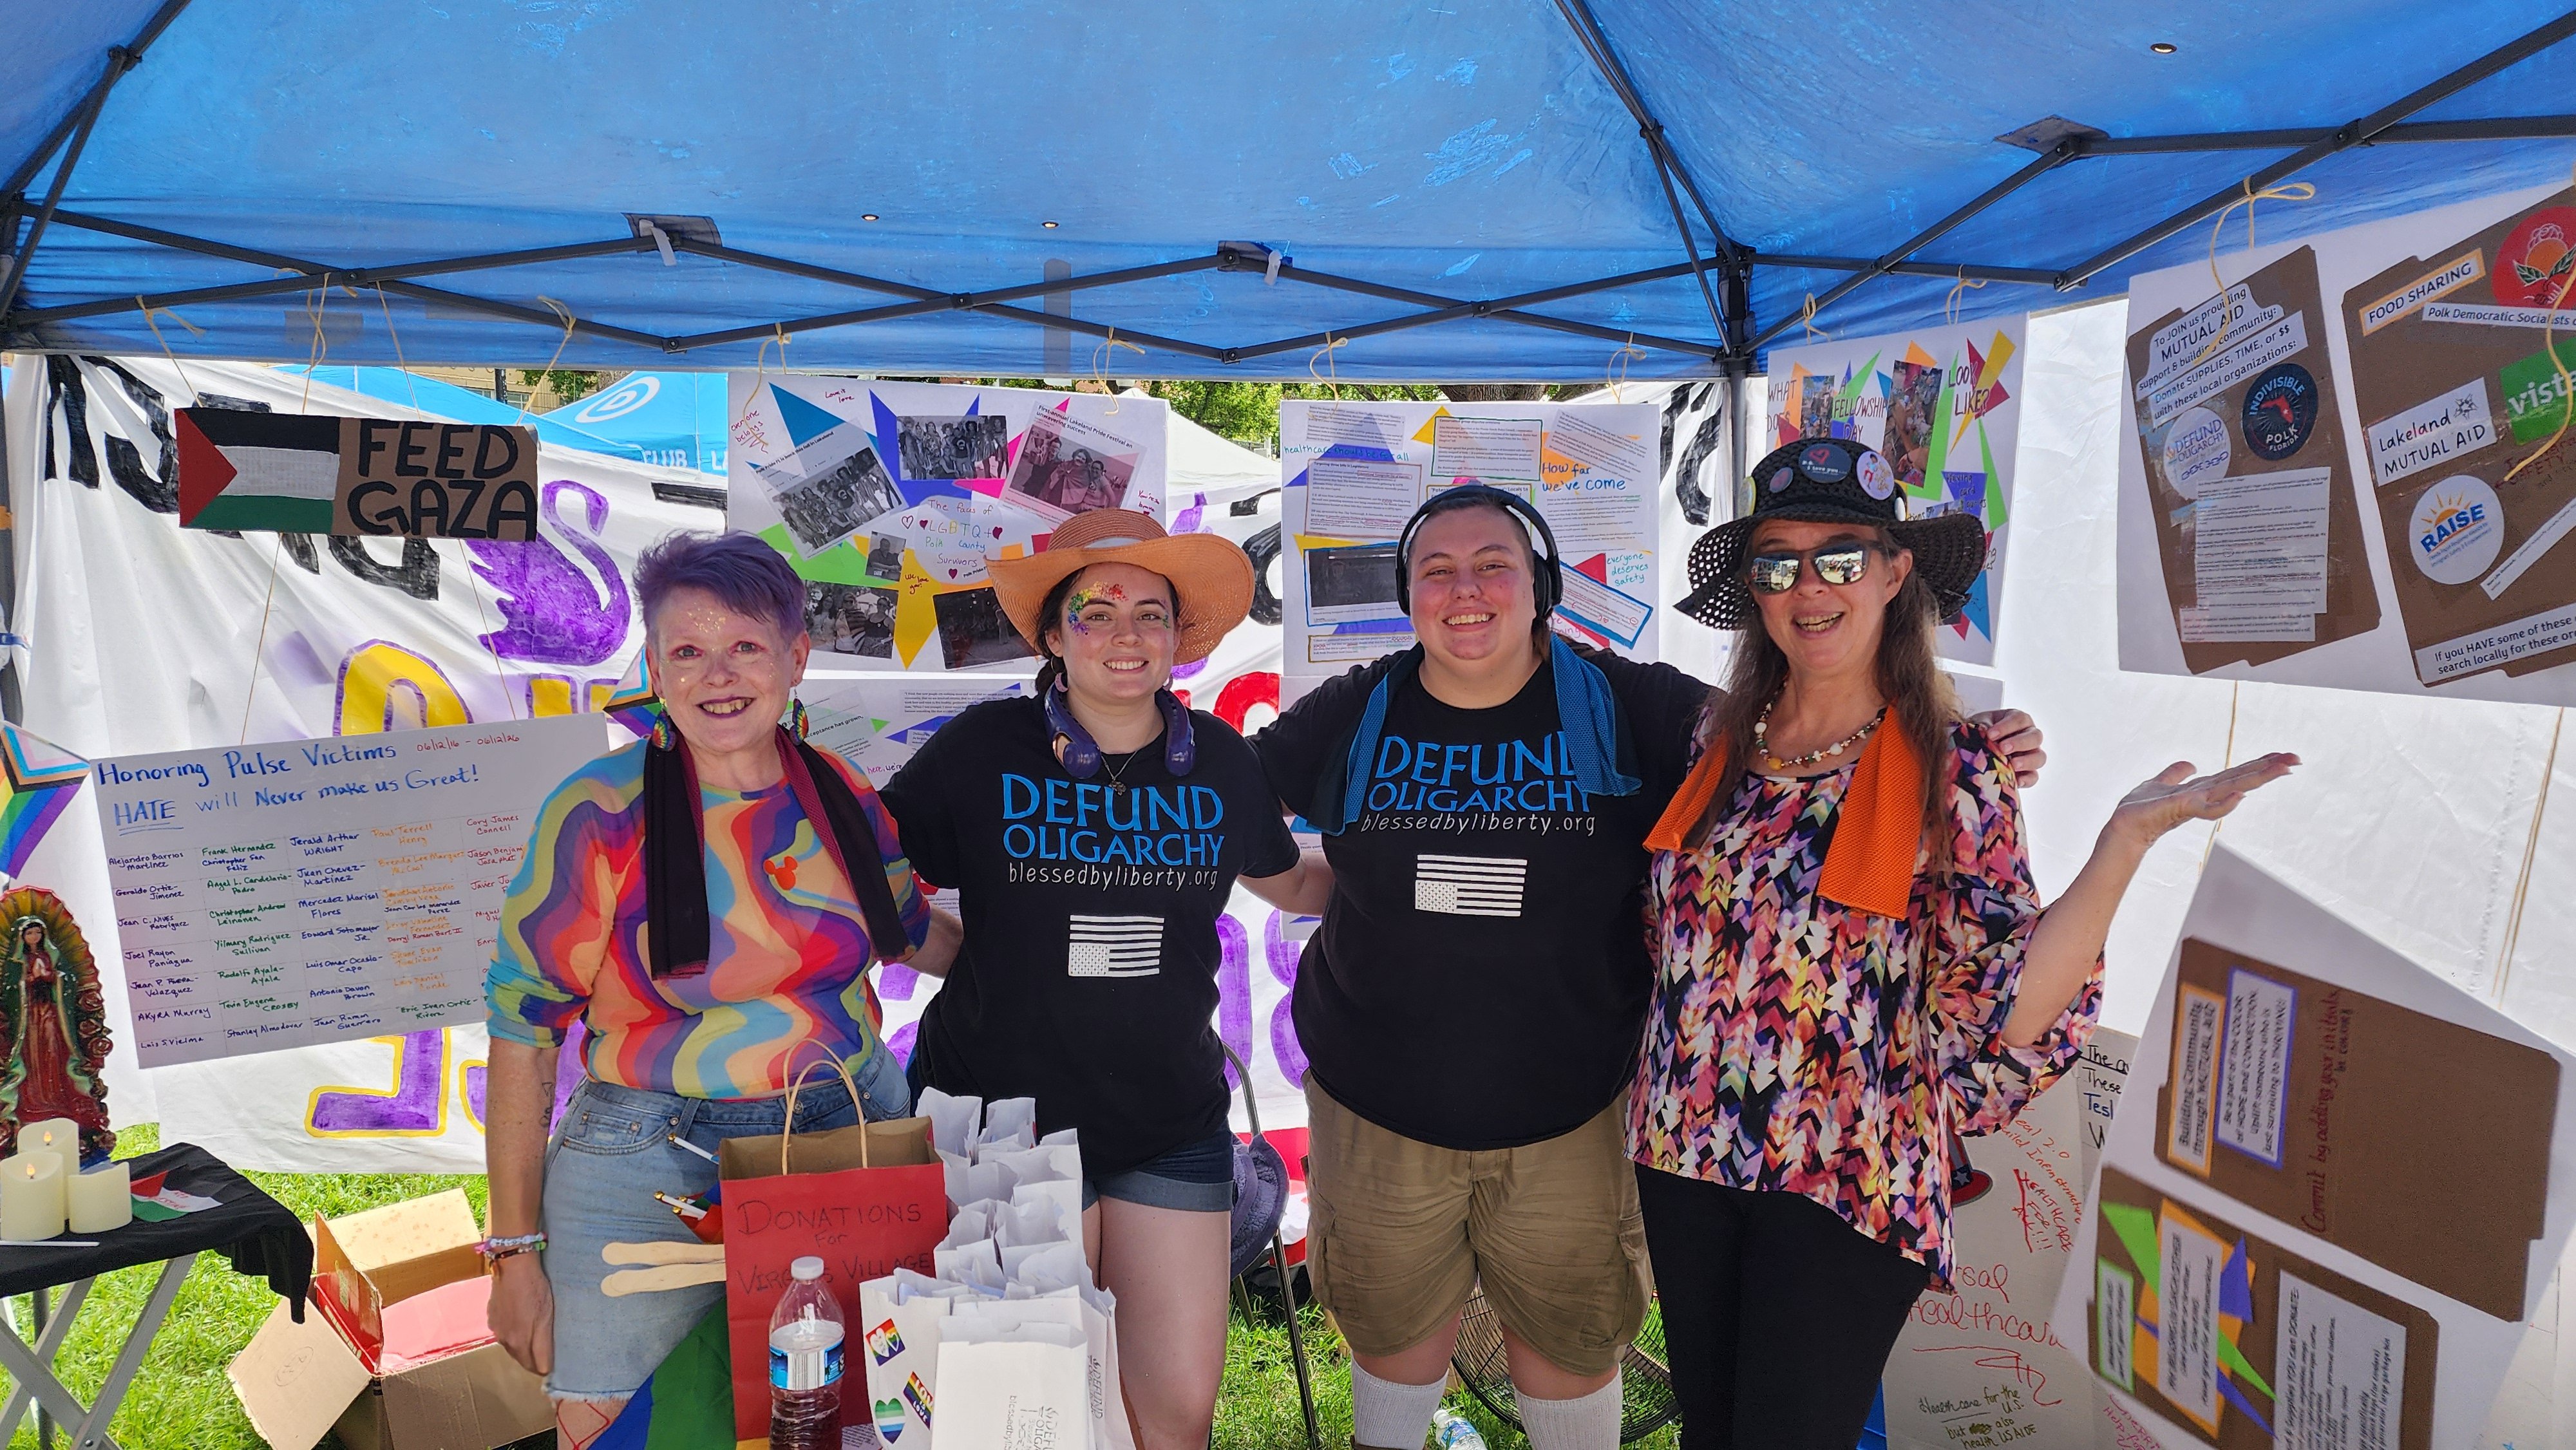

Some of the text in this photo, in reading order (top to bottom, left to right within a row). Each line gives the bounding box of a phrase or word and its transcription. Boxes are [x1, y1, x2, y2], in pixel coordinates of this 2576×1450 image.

[2369, 263, 2471, 323] FOOD SHARING
[2428, 308, 2569, 325] Polk Democratic Socialsts
[2161, 305, 2244, 361] MUTUAL AID
[2166, 323, 2187, 341] JOIN
[2190, 317, 2199, 326] us
[2139, 308, 2277, 391] support & community:
[1949, 361, 1978, 387] LOOK
[2155, 325, 2289, 403] Donate SUPPLIES, TIME, or $$
[1768, 380, 1796, 402] WHAT
[1839, 376, 1848, 394] A
[2155, 340, 2297, 419] with these local organizations:
[1955, 388, 1990, 416] LIKE?
[2249, 376, 2306, 416] INDIVISIBLE
[2509, 372, 2576, 416] vist
[1833, 395, 1888, 419] FELLOWSHIP
[1037, 411, 1086, 435] unwavering success
[1069, 417, 1092, 431] Lakeland
[1093, 428, 1106, 437] Pride
[1106, 432, 1125, 446] Festival
[1767, 411, 1790, 432] DOES
[1844, 424, 1863, 443] DAY
[2379, 408, 2450, 452] Lakeland
[2175, 419, 2221, 452] DEFUND
[2266, 424, 2298, 444] POLK
[2269, 435, 2299, 451] FLORIDA
[358, 419, 517, 478] FEED
[644, 449, 687, 467] CLUB
[1284, 444, 1331, 454] healthcare
[1397, 452, 1408, 460] all
[2177, 431, 2224, 463] OLIGARCHY
[2385, 424, 2486, 476] MUTUAL AID
[1542, 463, 1591, 476] How far
[1542, 480, 1625, 491] we've come
[348, 480, 538, 541] GAZA
[928, 500, 993, 515] The faces of
[2420, 504, 2486, 554] RAISE
[925, 537, 943, 547] Polk
[937, 553, 977, 567] Survivors
[1607, 553, 1643, 565] everyone
[1612, 564, 1648, 575] deserves
[1615, 574, 1644, 586] safety
[2435, 617, 2571, 661] If you HAVE some of these
[2438, 636, 2559, 674] search locally for these
[98, 762, 209, 787] Honoring
[222, 751, 291, 778] Pulse
[301, 744, 396, 767] Victims
[115, 764, 478, 825] HATE will Never make us Great!
[1001, 774, 1223, 831] DEFUND
[1368, 780, 1589, 812] OLIGARCHY
[1361, 814, 1595, 836] blessedbyliberty.org
[202, 847, 227, 856] Frank
[289, 834, 359, 847] Jerald Arthur
[304, 845, 344, 856] WRIGHT
[1004, 824, 1224, 866] OLIGARCHY
[1009, 862, 1218, 891] blessedbyliberty.org
[346, 892, 379, 901] Marisol
[312, 909, 341, 919] Flores
[251, 976, 280, 985] Ayala
[2087, 1045, 2113, 1066] The
[2082, 1067, 2121, 1094] These
[2300, 1171, 2327, 1233] Commit
[737, 1200, 921, 1235] DONATIONS
[1984, 1386, 1998, 1403] for
[2002, 1384, 2020, 1399] the
[1945, 1417, 2014, 1439] but also
